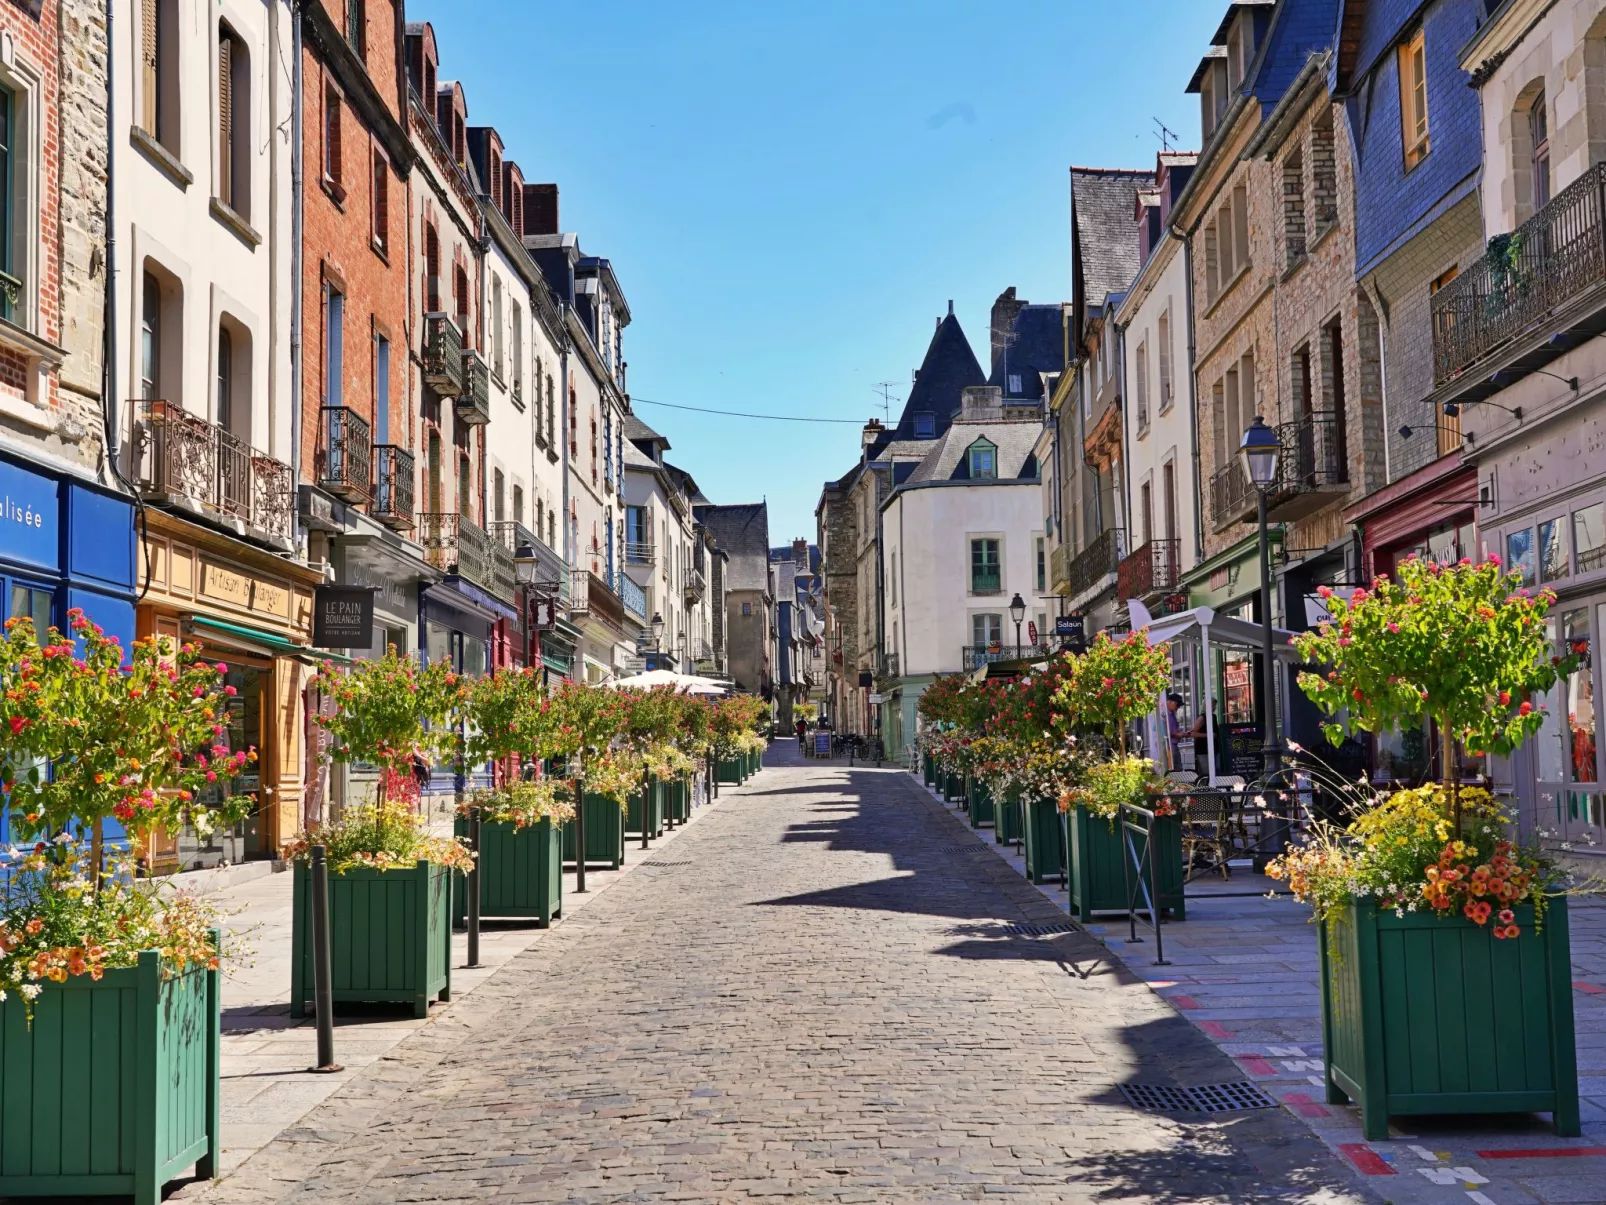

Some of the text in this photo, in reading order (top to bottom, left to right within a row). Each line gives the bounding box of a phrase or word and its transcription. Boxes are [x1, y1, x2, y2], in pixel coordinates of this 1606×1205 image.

[243, 577, 282, 612] Bulanger
[326, 601, 361, 615] LE PAIN
[325, 614, 361, 625] BOULANGER
[1029, 622, 1037, 645] TABAC
